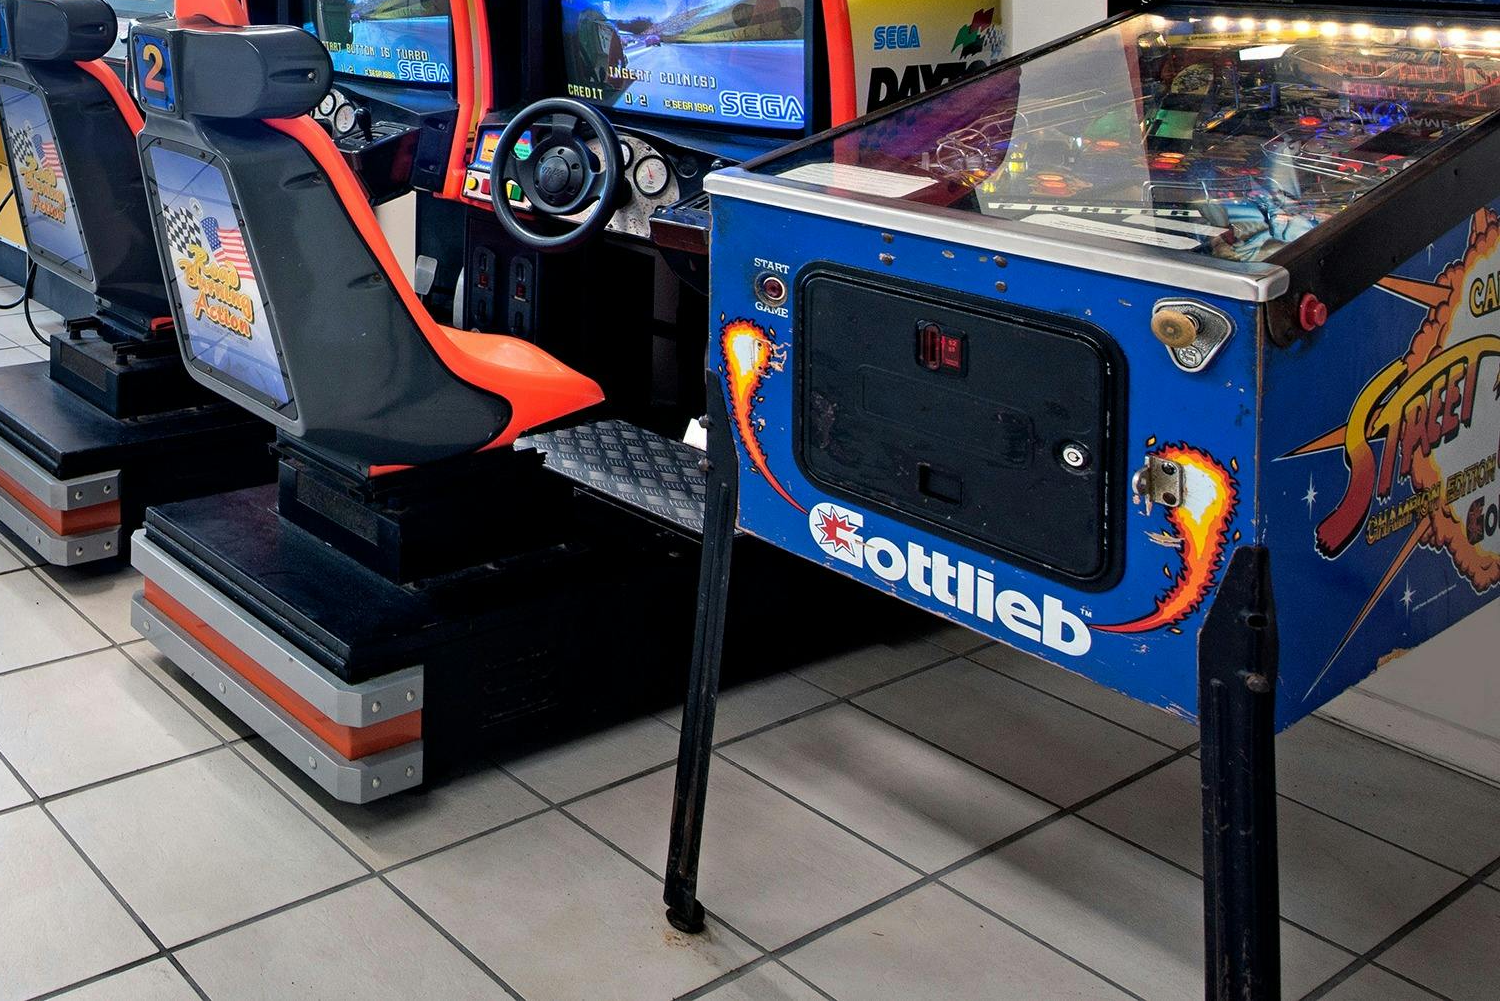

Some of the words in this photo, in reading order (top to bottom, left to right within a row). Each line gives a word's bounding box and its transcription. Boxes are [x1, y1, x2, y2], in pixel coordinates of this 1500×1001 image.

[346, 43, 376, 55] BUTTON
[380, 46, 391, 58] IS
[396, 48, 428, 61] TURBO
[873, 24, 921, 49] SEGA
[142, 45, 166, 94] 2
[397, 60, 450, 83] SEGA
[608, 65, 652, 82] INSERT
[659, 71, 717, 89] COIN(S)
[567, 83, 604, 100] CREDIT
[719, 90, 804, 121] SEGA
[30, 191, 67, 224] Action
[186, 243, 242, 291] Road
[754, 257, 790, 275] START
[177, 259, 254, 324] Burning
[194, 291, 253, 340] Action
[754, 301, 789, 318] GAME
[1314, 333, 1500, 560] STREET
[1365, 480, 1442, 545] CHAMPION
[1445, 452, 1498, 503] EDITION
[809, 502, 1091, 657] Gottlieb
